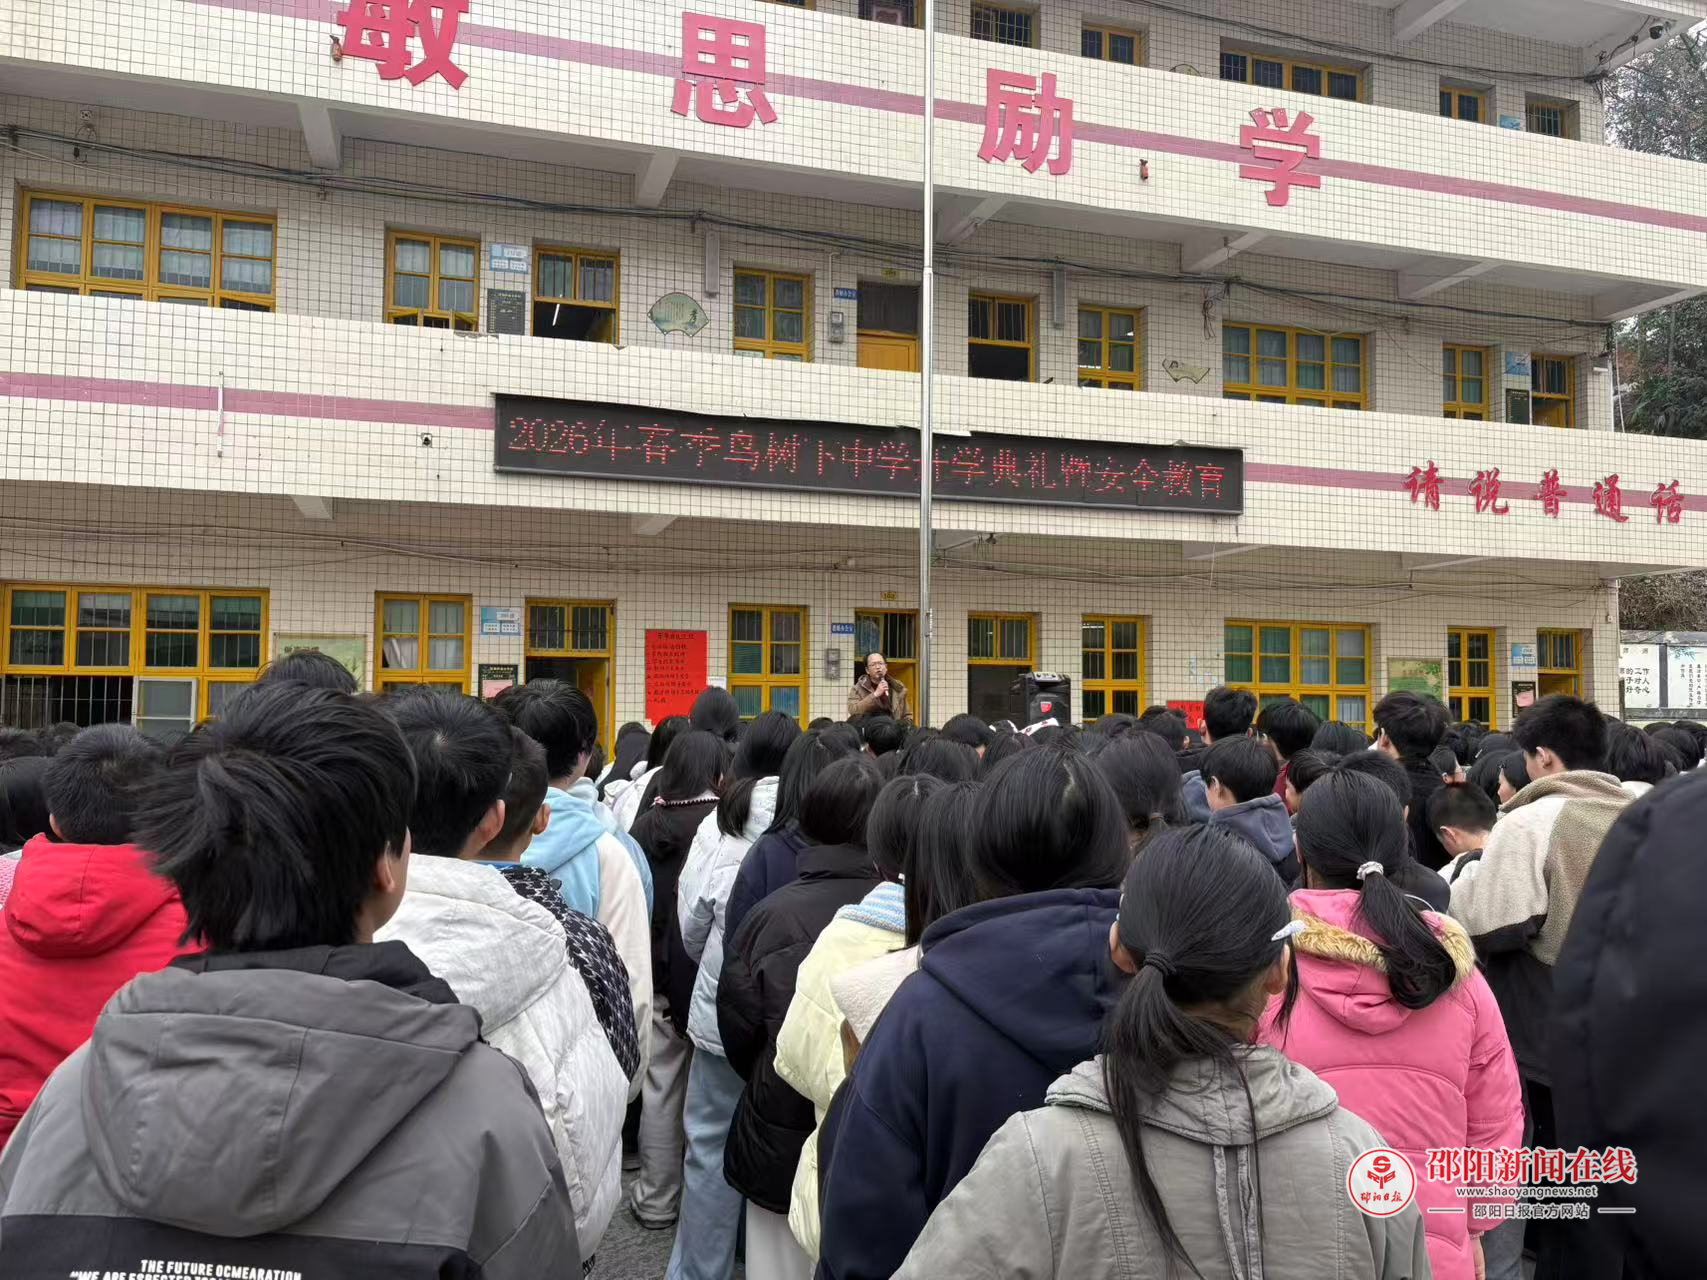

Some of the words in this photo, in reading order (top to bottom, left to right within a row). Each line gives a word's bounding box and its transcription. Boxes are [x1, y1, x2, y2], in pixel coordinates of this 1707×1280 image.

[336, 0, 1321, 207] 敏思励学
[1403, 460, 1685, 524] 请说普通话
[141, 1260, 164, 1273] THE
[166, 1261, 213, 1276] FUTURE
